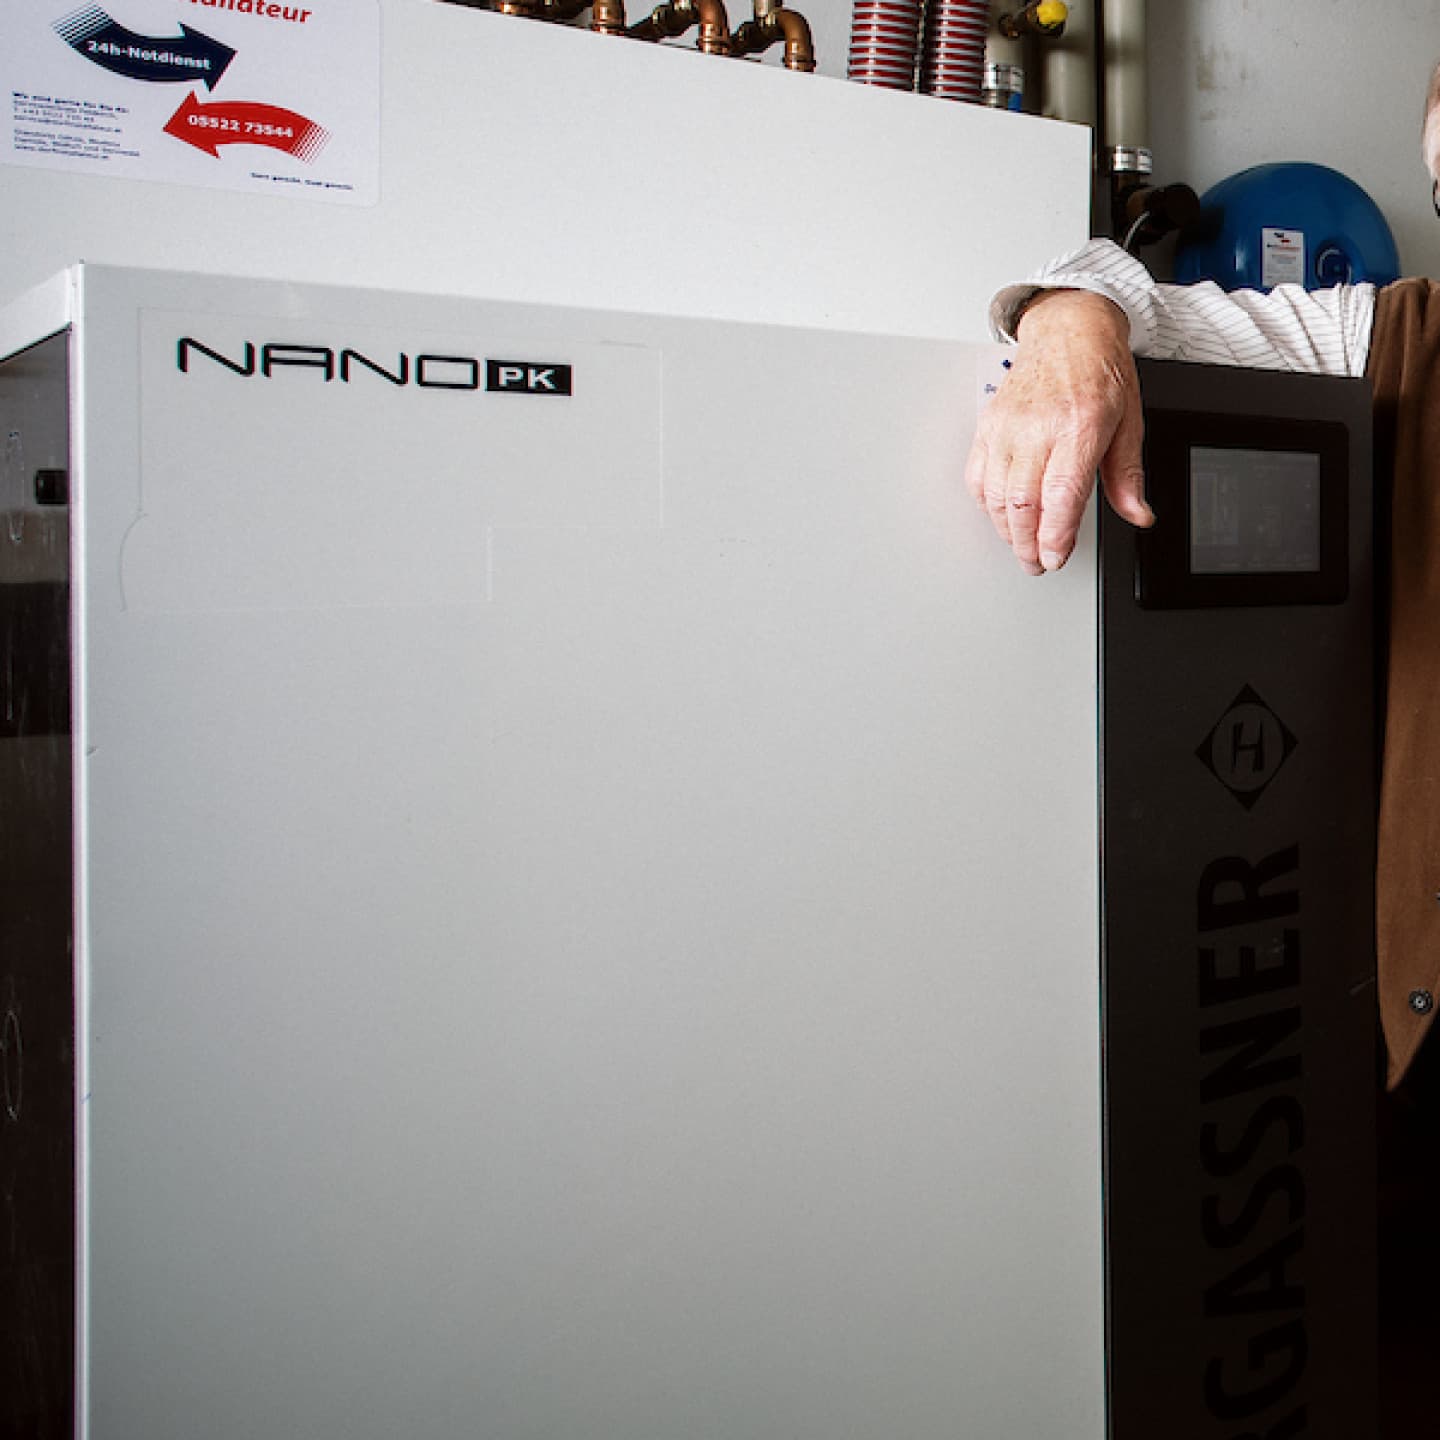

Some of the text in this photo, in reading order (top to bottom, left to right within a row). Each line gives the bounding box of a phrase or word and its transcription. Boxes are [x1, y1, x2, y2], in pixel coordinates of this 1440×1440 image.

[87, 40, 211, 70] 24h-Notdienst
[187, 114, 294, 138] 05522 73544
[177, 337, 556, 391] NANO PK
